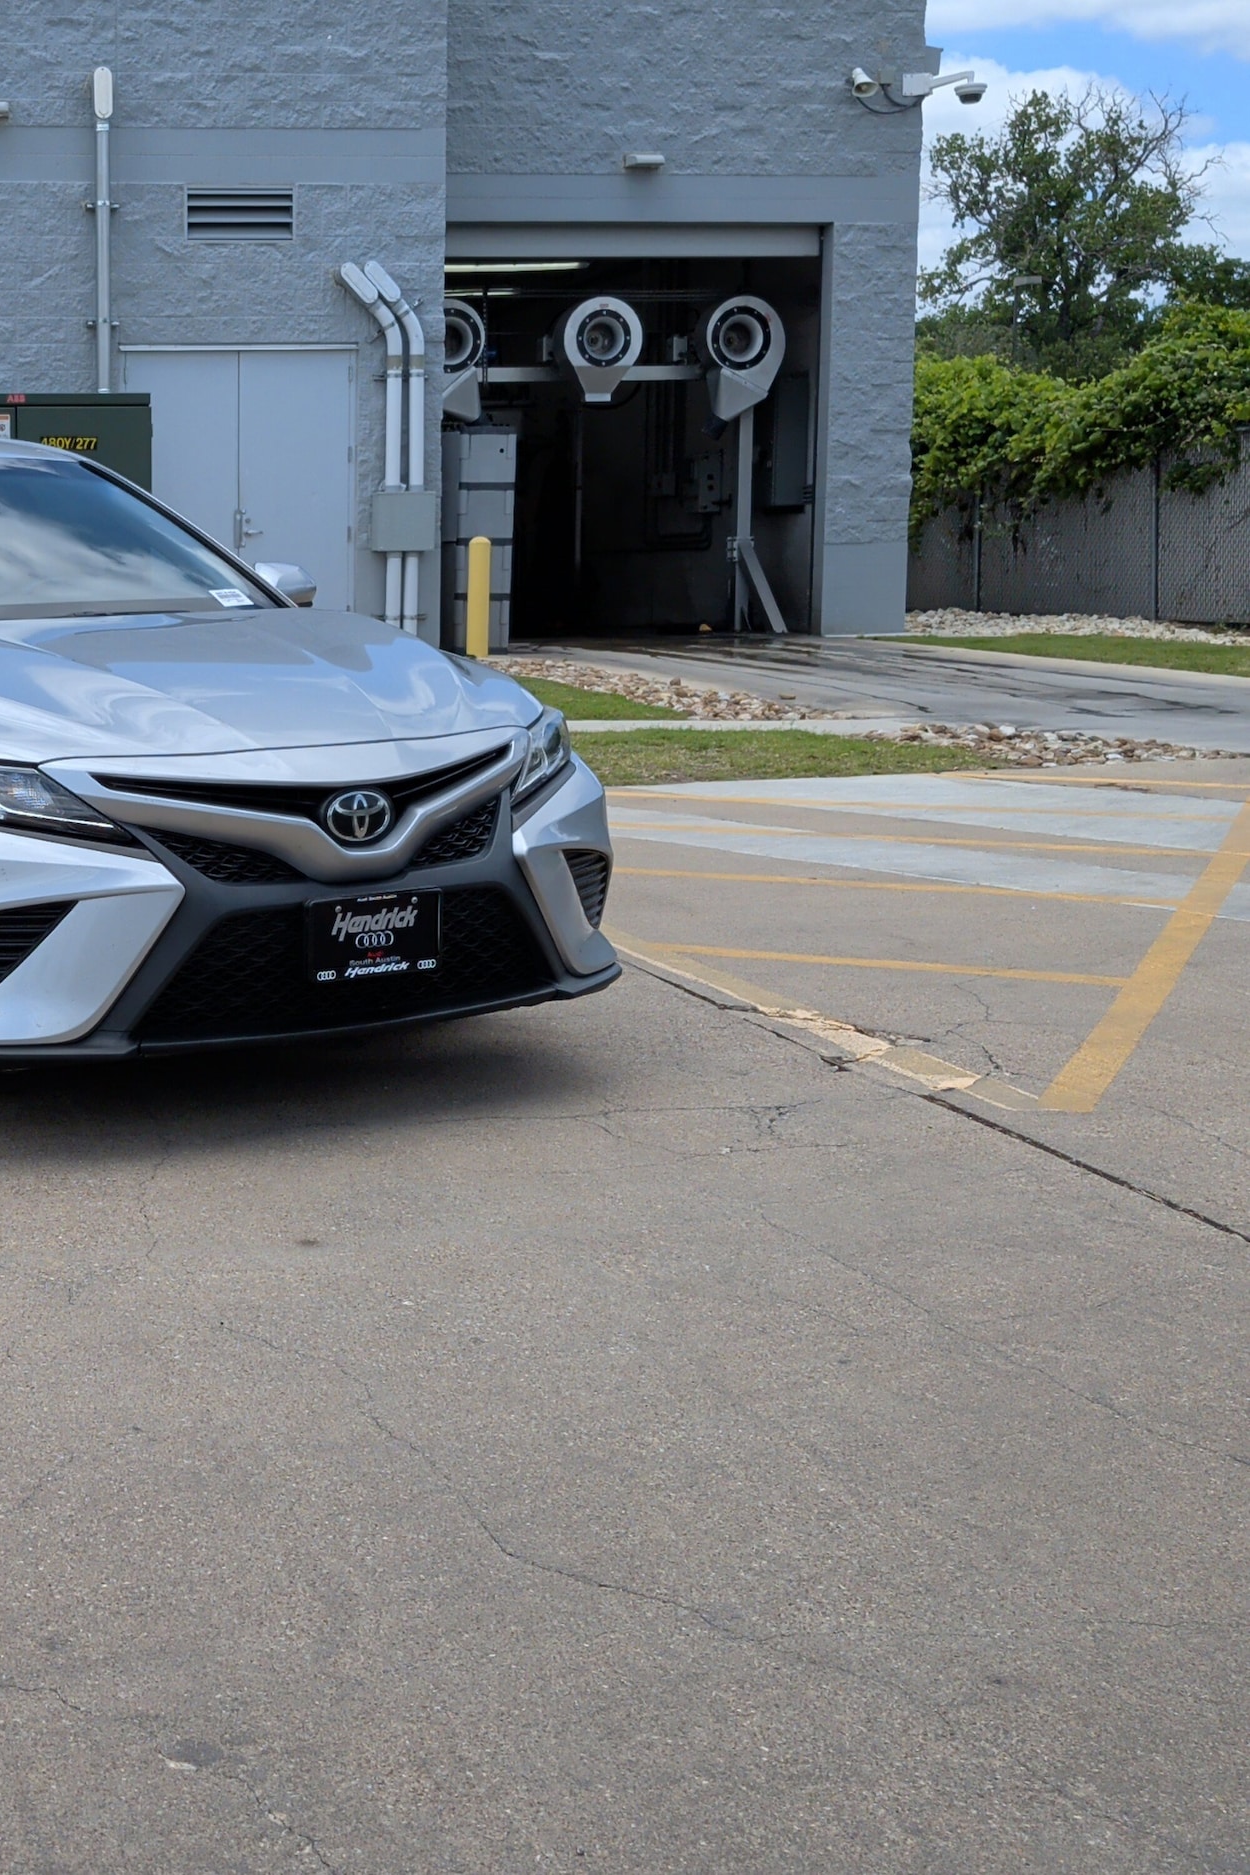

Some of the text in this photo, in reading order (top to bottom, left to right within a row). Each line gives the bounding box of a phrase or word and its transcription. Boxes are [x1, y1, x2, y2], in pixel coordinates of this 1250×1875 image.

[6, 394, 26, 403] ABB
[331, 905, 418, 942] Hendrick
[349, 955, 401, 966] South Austin
[344, 961, 410, 978] Hendrick
